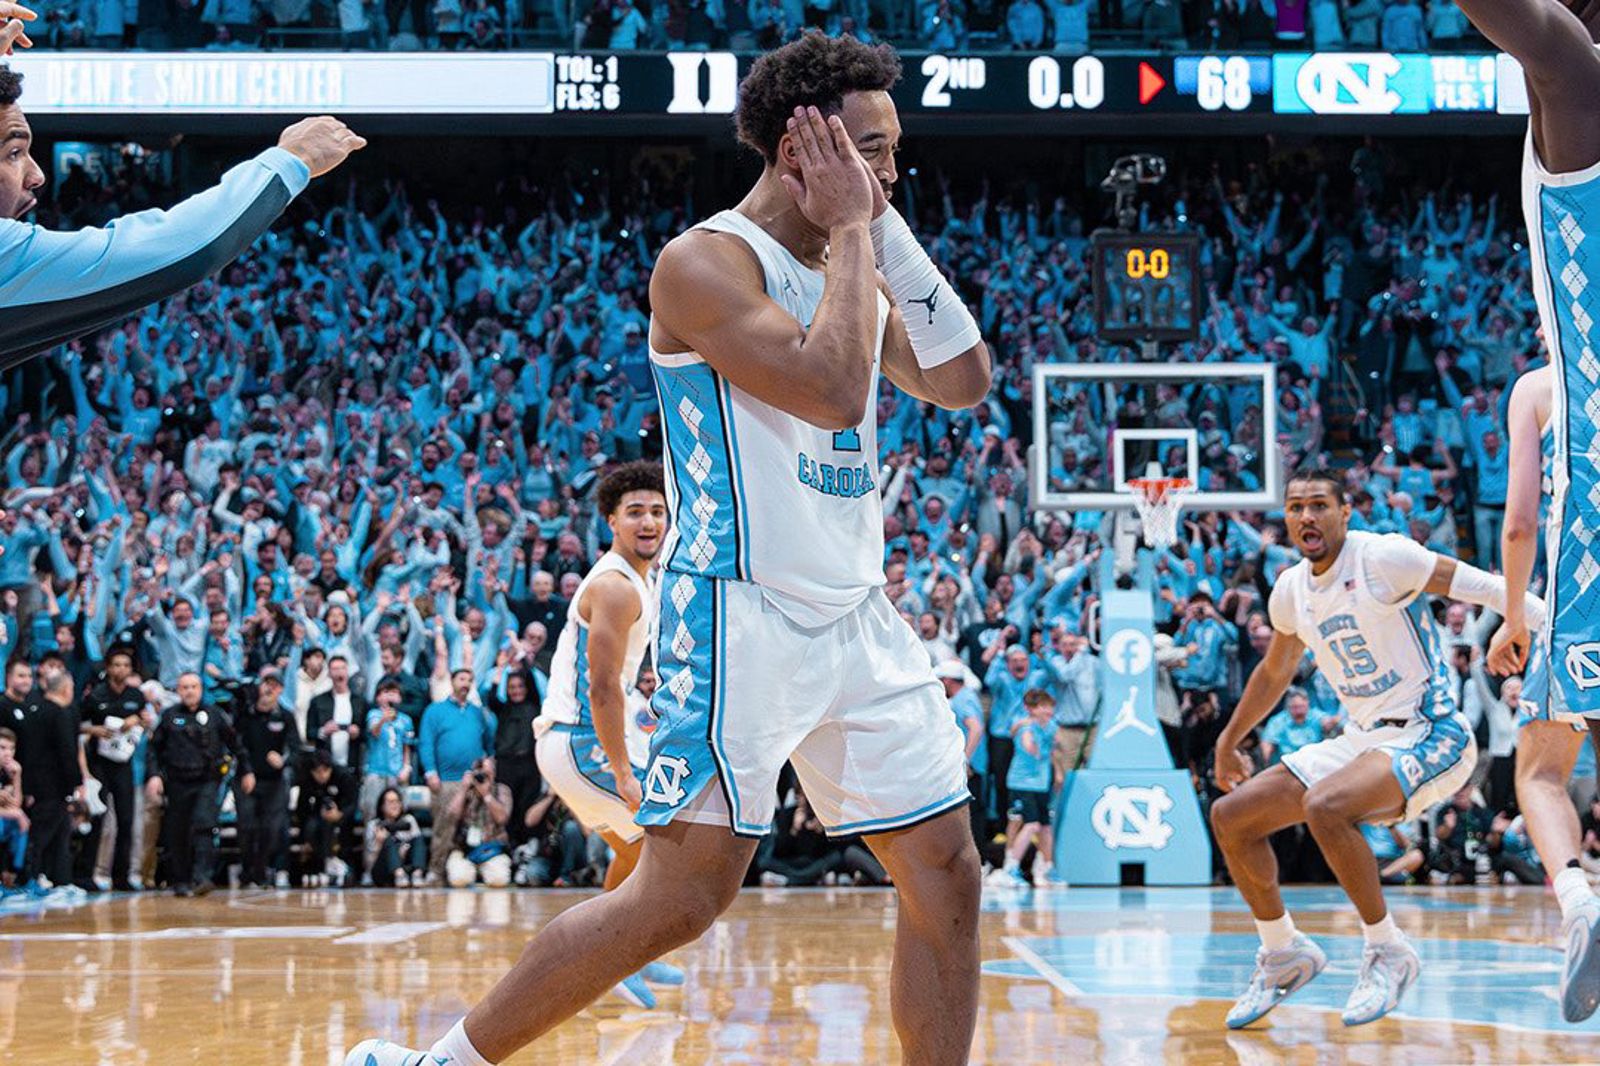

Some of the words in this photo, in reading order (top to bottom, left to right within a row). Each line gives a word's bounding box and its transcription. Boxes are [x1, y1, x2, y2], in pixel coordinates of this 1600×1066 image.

[48, 61, 111, 105] DEAN
[154, 61, 239, 105] SMITH
[246, 61, 344, 105] CENTER
[1028, 56, 1104, 109] 0.0
[1197, 56, 1251, 110] 68
[1329, 634, 1378, 678] 15
